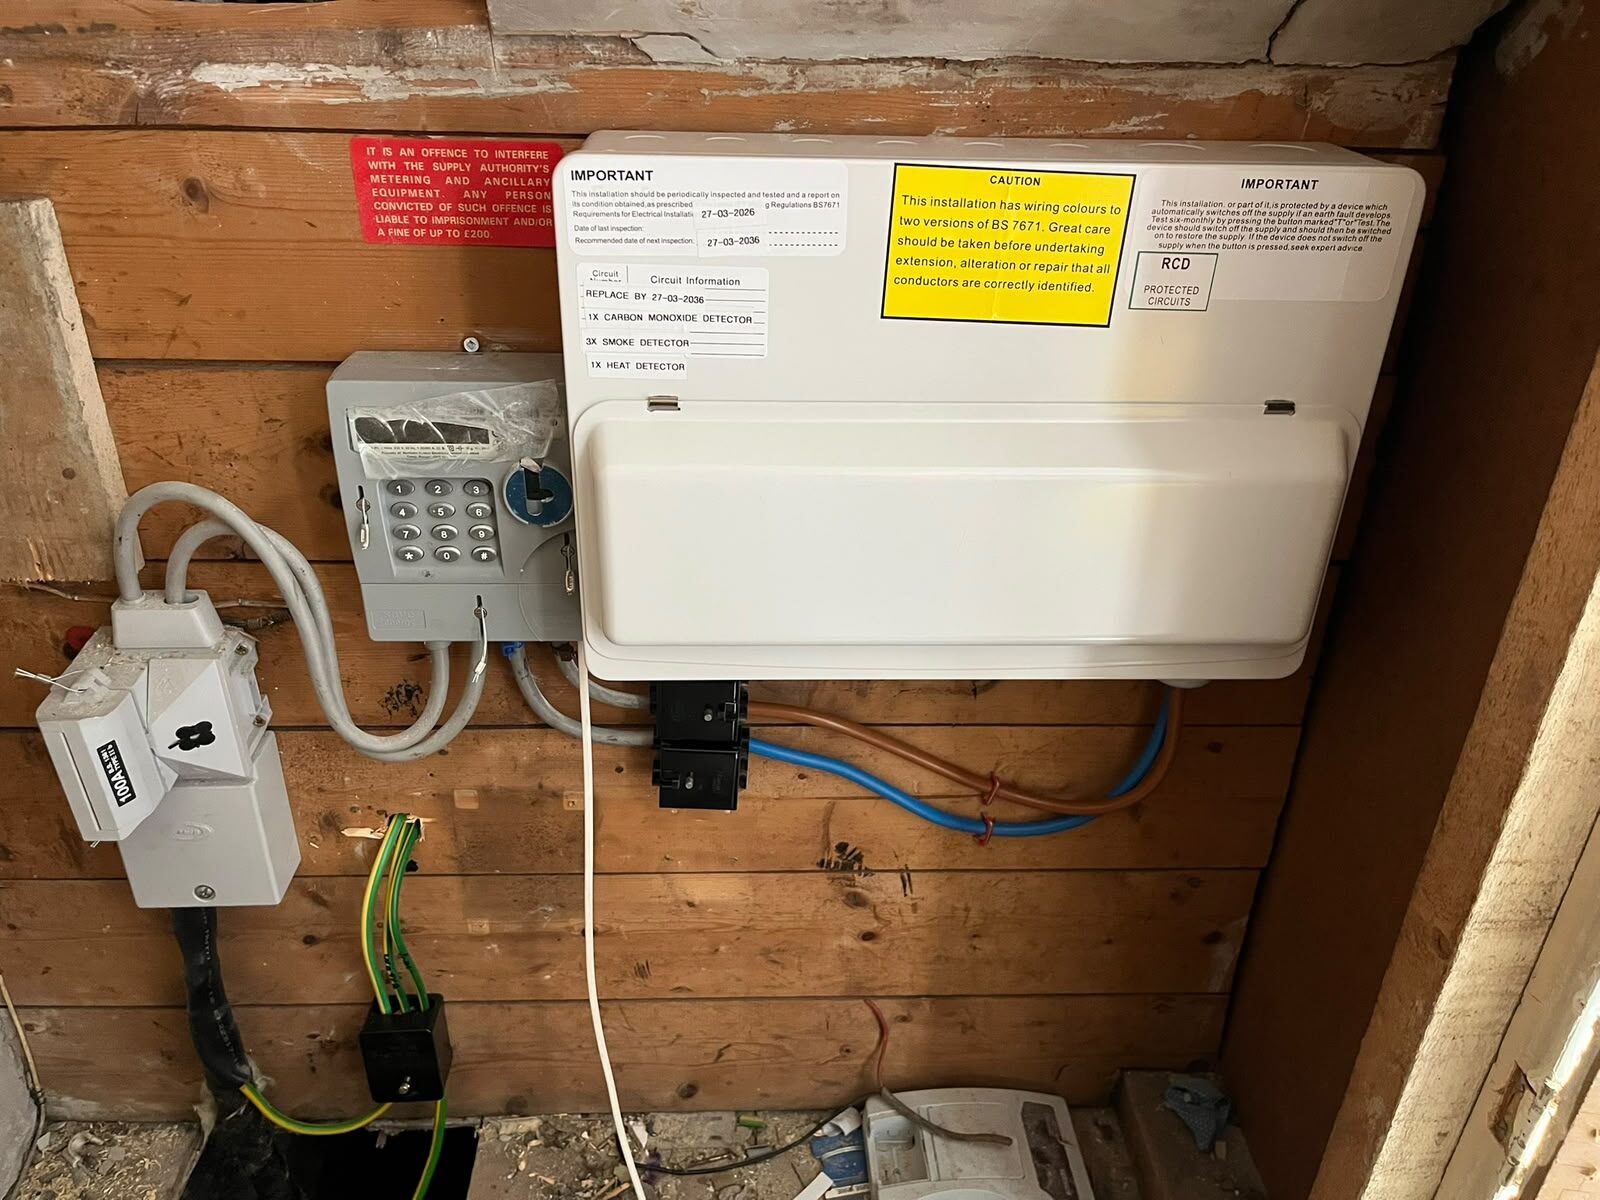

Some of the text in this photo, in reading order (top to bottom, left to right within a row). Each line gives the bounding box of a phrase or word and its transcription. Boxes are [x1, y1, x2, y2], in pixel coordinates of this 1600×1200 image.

[367, 147, 549, 160] IT IS AN OFFENCE TO INTERFERE
[368, 161, 549, 173] WITH THE SUPPLY AUTHORITY'S
[571, 170, 653, 180] IMPORTANT
[370, 175, 550, 186] METERING AND ANCILLARY
[990, 175, 1041, 186] CAUTION
[1241, 179, 1319, 189] IMPORTANT
[372, 189, 551, 200] EQUIPMENT. ANY PERSON
[374, 202, 551, 213] CONVICTED OF SUCH OFFENCE IS
[902, 195, 1121, 215] This installation has wiring colours to
[1320, 203, 1328, 211] by
[702, 208, 755, 218] 27-03-2026
[1152, 208, 1204, 216] automatically
[1268, 210, 1294, 218] supply
[375, 215, 553, 226] LIABLE TO IMPRISONMENT AND/OR
[900, 216, 1111, 234] two versions of BS 7671. Great care
[1170, 217, 1215, 225] six-monthly
[1217, 217, 1226, 225] by
[388, 229, 410, 237] FINE
[413, 229, 426, 238] OF
[430, 230, 442, 238] UP
[446, 230, 460, 238] TO
[708, 236, 760, 246] 27-03-2036
[898, 236, 1105, 256] should be taken before undertaking
[896, 256, 1110, 275] extension, alteration or repair that all
[1162, 258, 1190, 270] RCD
[650, 276, 740, 286] Circuit Information
[894, 276, 1094, 292] conductors are correctly identified.
[1144, 285, 1199, 294] PROTECTED
[586, 290, 629, 299] REPLACE
[652, 294, 704, 303] 27-03-2036
[1148, 297, 1190, 306] CIRCUITS
[648, 314, 697, 322] MONOXIDE
[703, 315, 752, 323] DETECTOR
[602, 338, 634, 346] SMOKE
[640, 339, 689, 347] DETECTOR
[636, 362, 685, 370] DETECTOR
[396, 485, 401, 493] 1
[473, 486, 479, 494] 3
[438, 508, 444, 516] 5
[110, 757, 120, 771] TYPE
[111, 770, 132, 802] 100A
